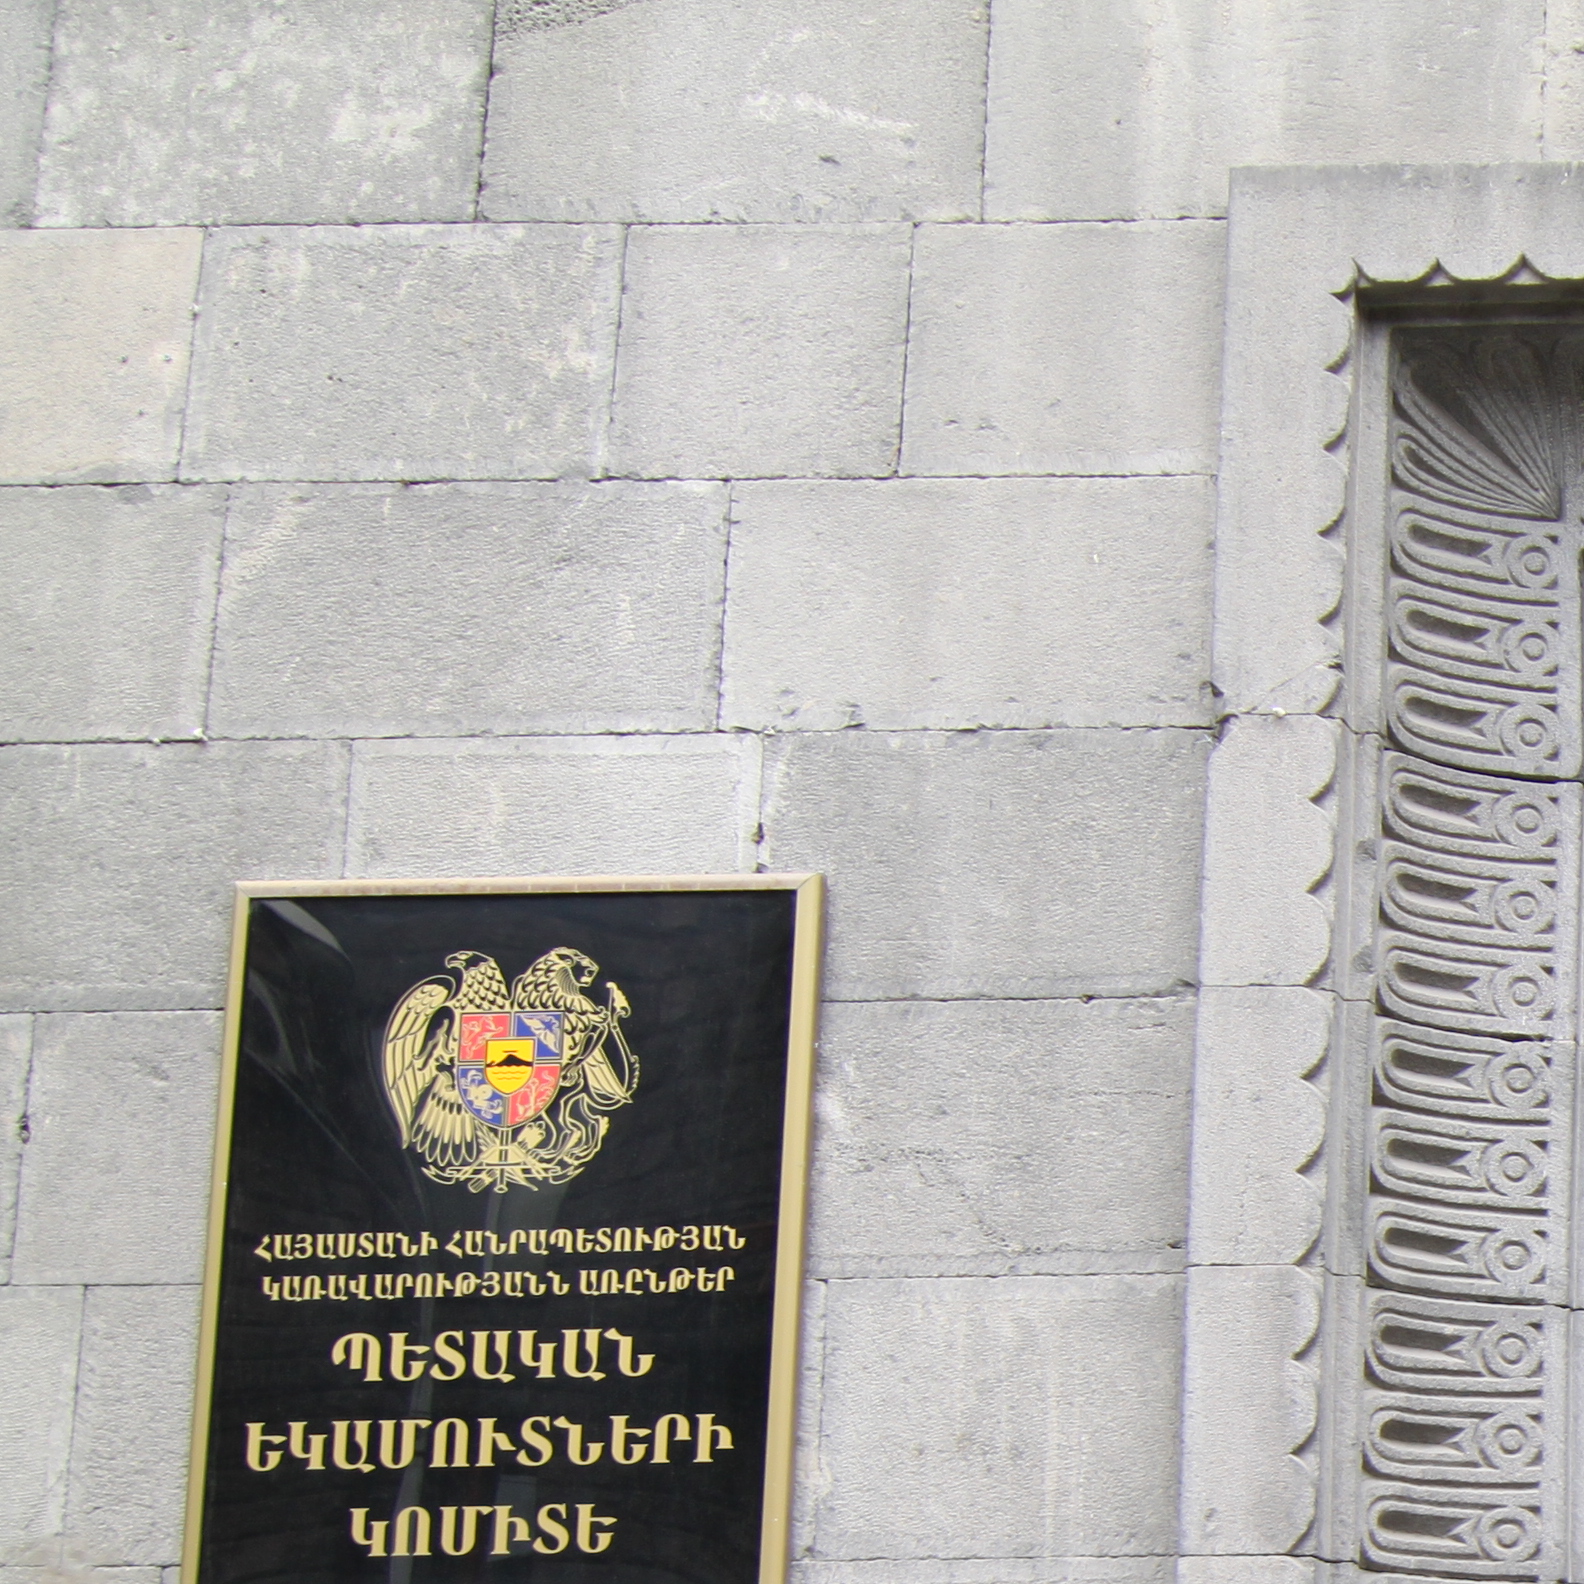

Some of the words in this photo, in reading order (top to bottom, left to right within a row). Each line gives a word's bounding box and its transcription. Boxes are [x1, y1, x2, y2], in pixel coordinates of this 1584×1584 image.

[254, 1231, 439, 1262] ՀԱՅԱՍՏԱՆԻ
[445, 1224, 746, 1259] ՀԱՆՐԱՊԵՏՈՒԹՅԱՆ
[262, 1270, 570, 1302] ԿԱՌԱՎԱՐՈՒԹՅԱՆՆ
[579, 1266, 735, 1296] ԱՌԸՆԹԵՐ
[331, 1327, 656, 1383] ՊԵՏԱԿԱՆ
[246, 1413, 734, 1474] ԵԿԱՄՈՒՏՆԵՐԻ
[350, 1503, 618, 1557] ԿՈՄԻՏԵ
